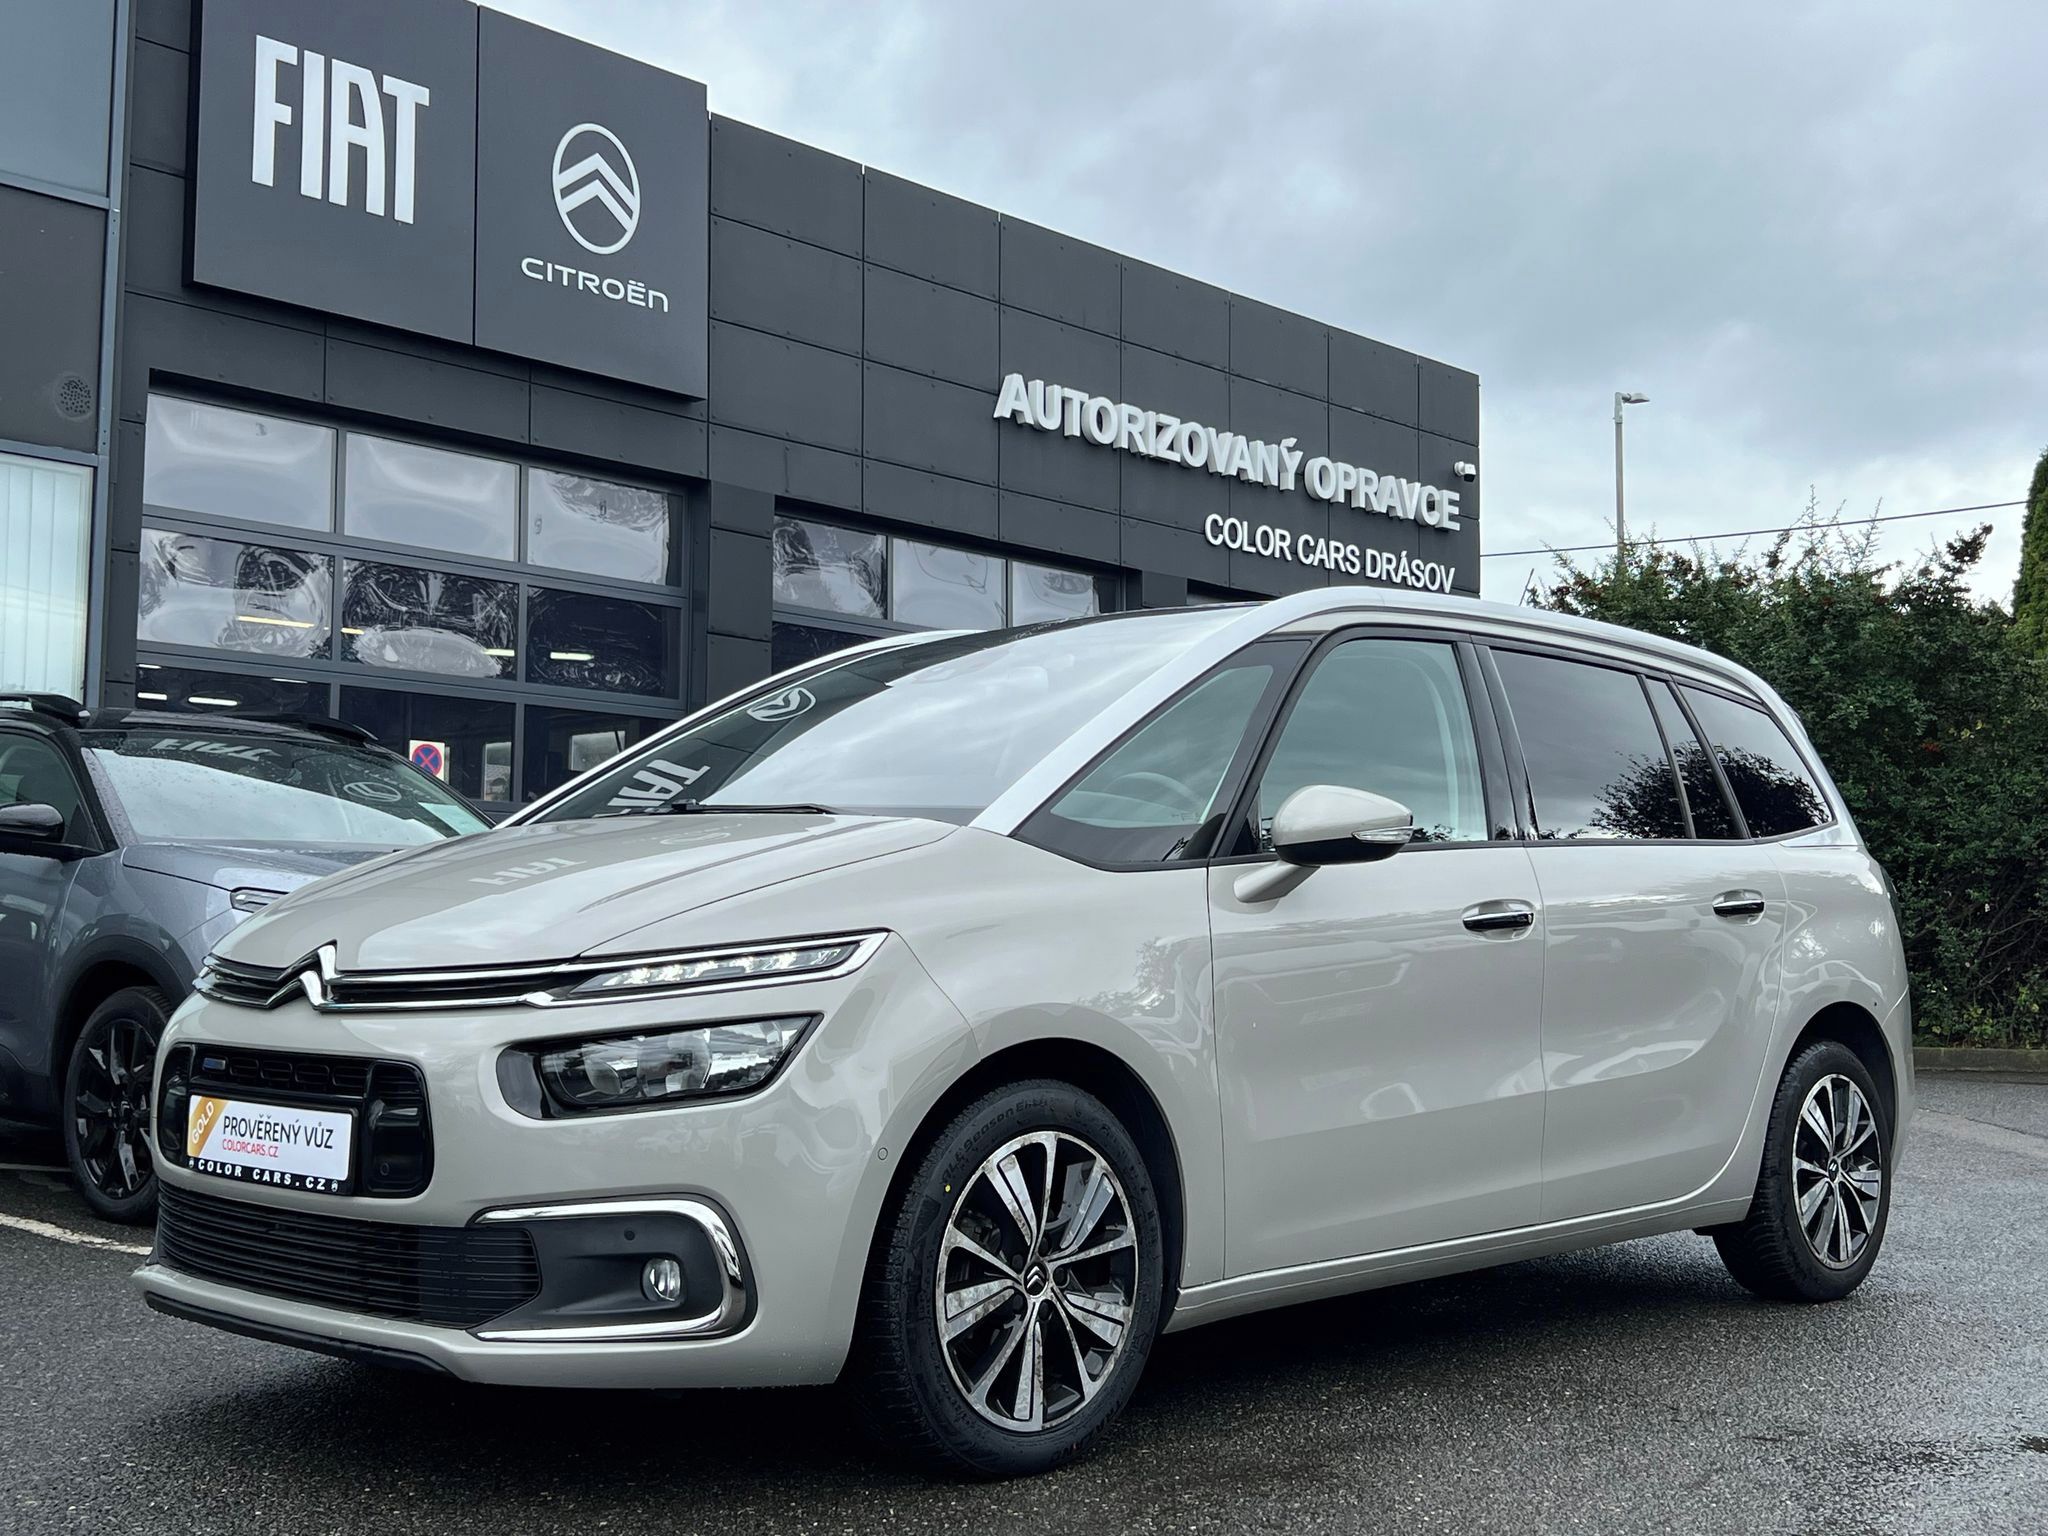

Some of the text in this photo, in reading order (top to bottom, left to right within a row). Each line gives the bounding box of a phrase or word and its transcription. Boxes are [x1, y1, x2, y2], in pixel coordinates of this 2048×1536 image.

[251, 35, 430, 225] FIAT
[993, 373, 1461, 532] AUTORIZOVANÝ OPRAVCE
[1204, 513, 1455, 594] COLOR CARS DRÁSOV
[191, 1101, 215, 1144] GOLD
[223, 1113, 334, 1149] PROVĚŘENÝ VŮZ
[198, 1159, 242, 1177] COLOR
[222, 1138, 279, 1158] COLORCARS.CZ
